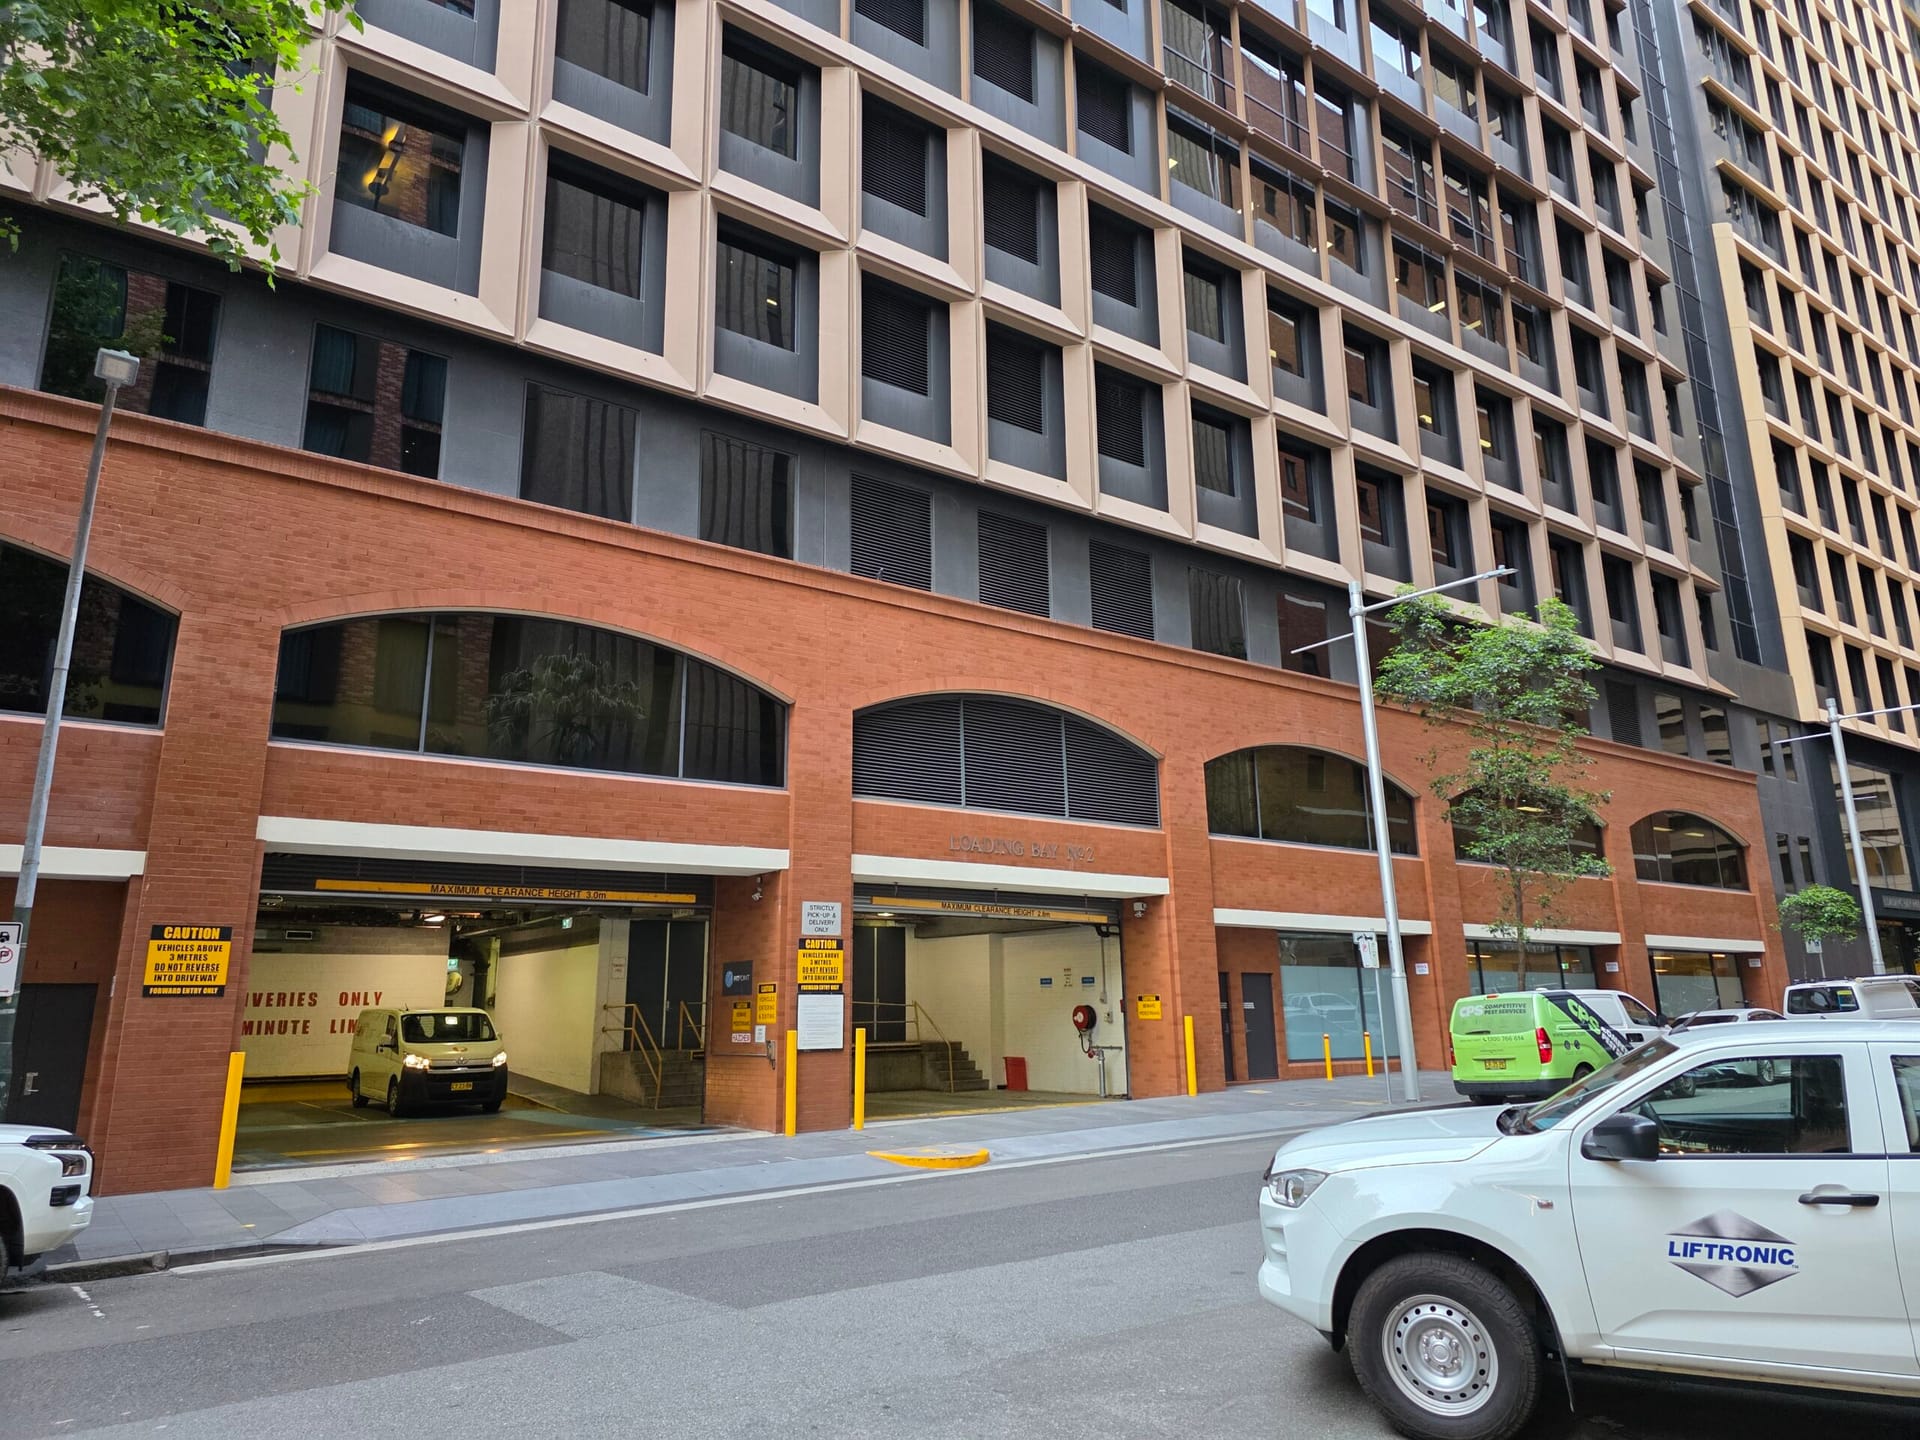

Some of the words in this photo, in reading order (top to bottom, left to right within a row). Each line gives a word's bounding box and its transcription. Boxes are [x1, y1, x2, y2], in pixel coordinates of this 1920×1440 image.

[950, 833, 1024, 856] LOADING
[1031, 842, 1058, 858] BAY
[430, 884, 480, 895] MAXIMUM
[484, 886, 544, 897] CLEARANCE
[548, 889, 581, 898] HEIGHT
[586, 891, 607, 899] 3.0m
[941, 902, 972, 910] MAXIMUM
[974, 904, 1011, 914] CLEARANCE
[1014, 908, 1035, 916] HEIGHT
[164, 927, 220, 939] CAUTION
[157, 944, 194, 952] VEHICLES
[805, 940, 837, 949] CAUTION
[154, 963, 166, 971] DO
[168, 963, 184, 971] NOT
[186, 963, 220, 972] REVERSE
[244, 992, 318, 1007] IVERIES
[339, 992, 383, 1006] ONLY
[1459, 1005, 1483, 1017] CPS
[1567, 999, 1601, 1035] CPS
[241, 1020, 310, 1036] MINUTE
[1668, 1241, 1794, 1265] LIFTRONIC
